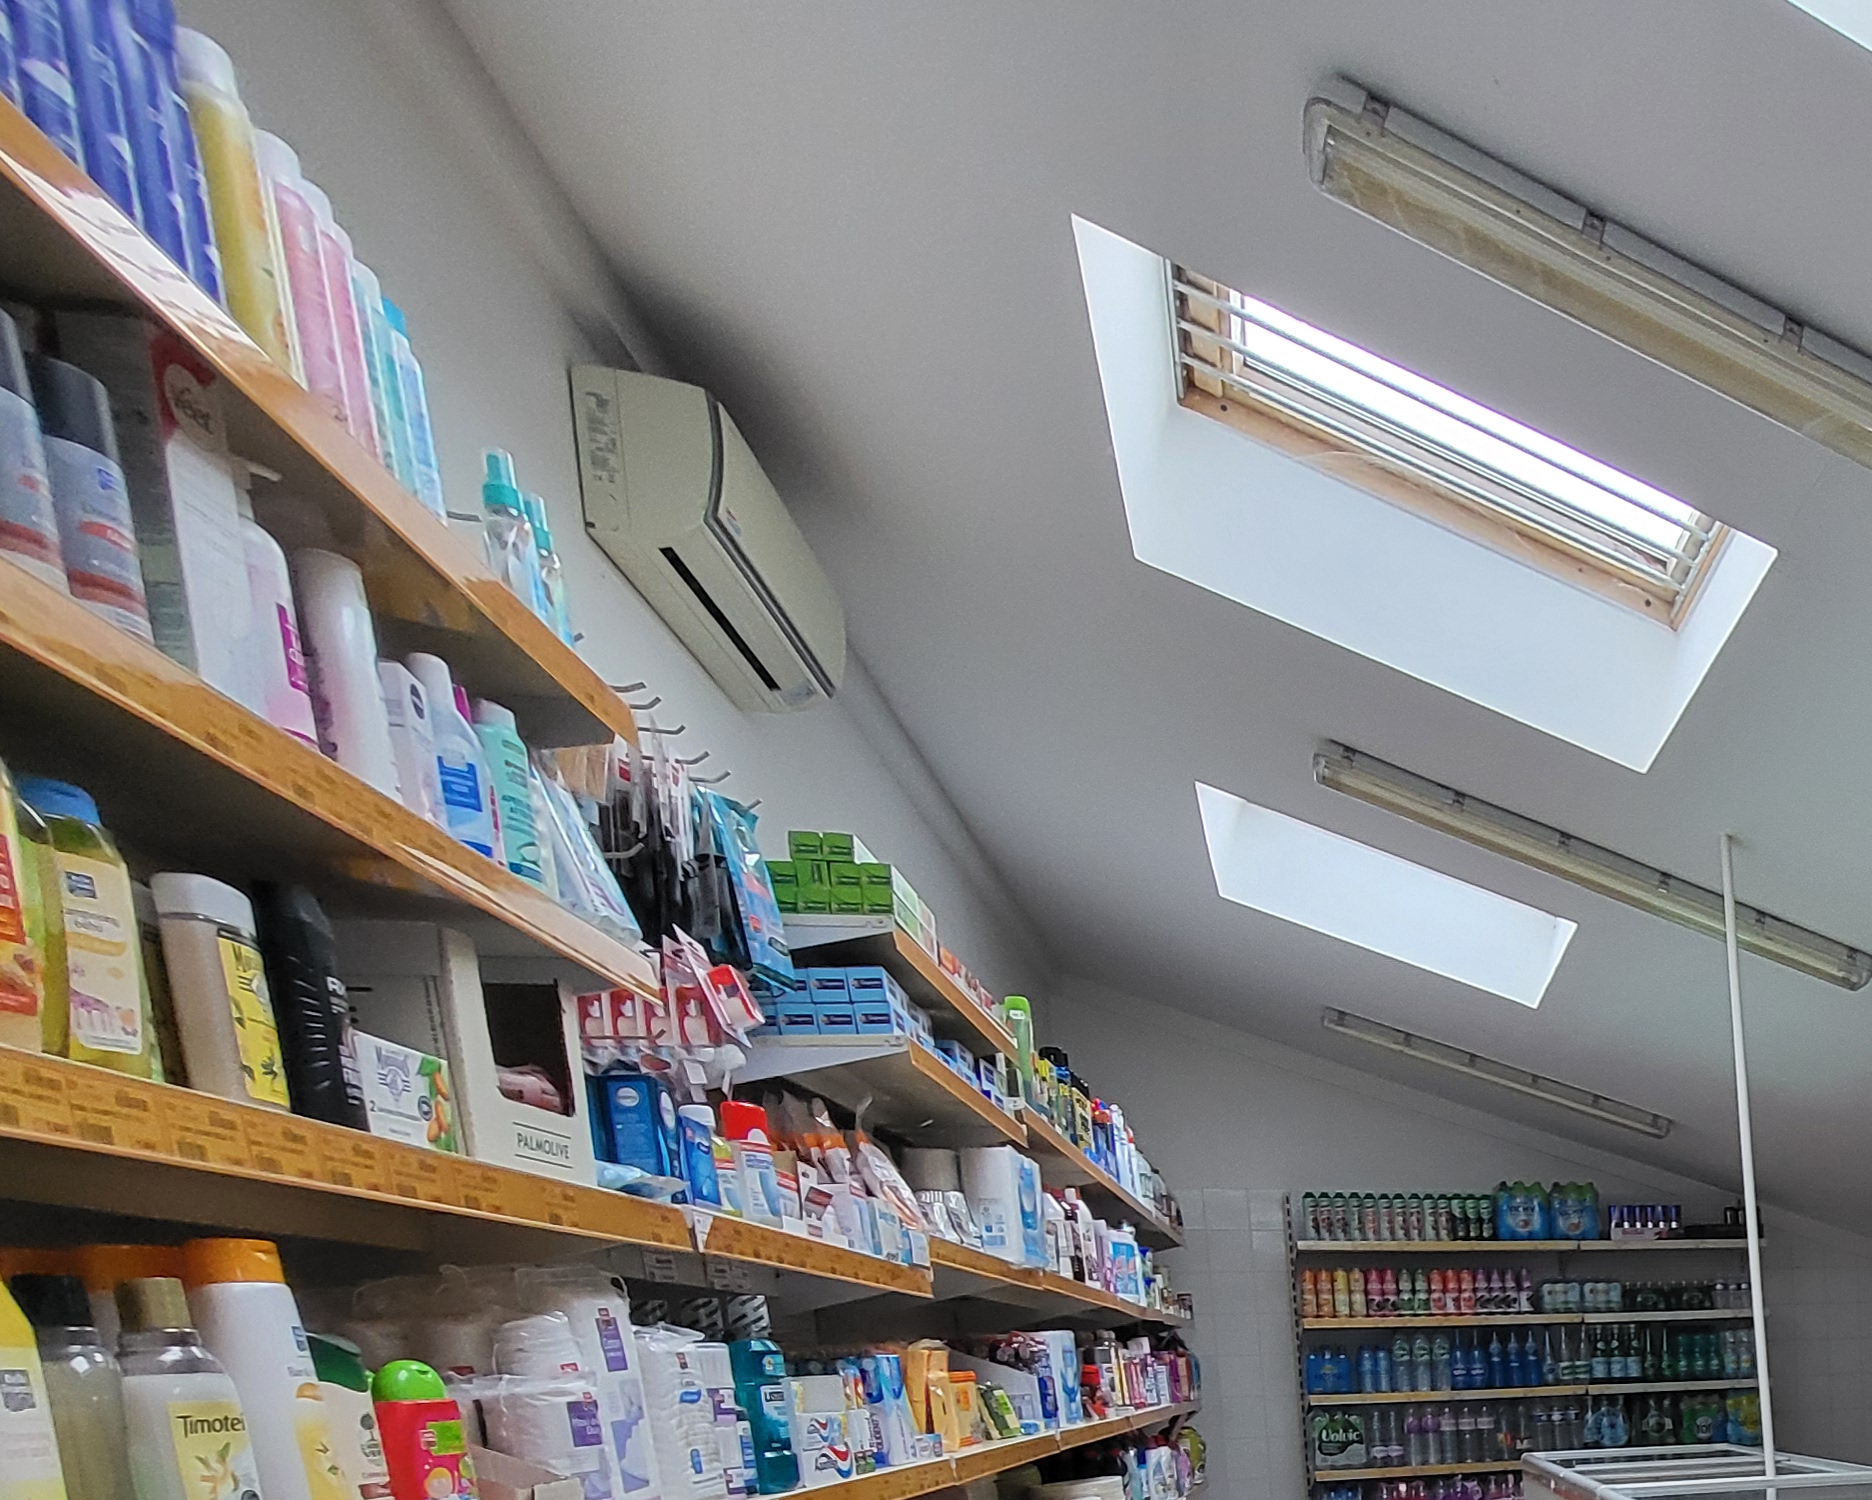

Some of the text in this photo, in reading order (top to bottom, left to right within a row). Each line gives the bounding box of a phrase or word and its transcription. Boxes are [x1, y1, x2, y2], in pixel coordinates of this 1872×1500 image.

[517, 1132, 570, 1160] PALMOLIVE
[176, 1412, 246, 1438] Timotei
[1321, 1429, 1361, 1442] Volvic
